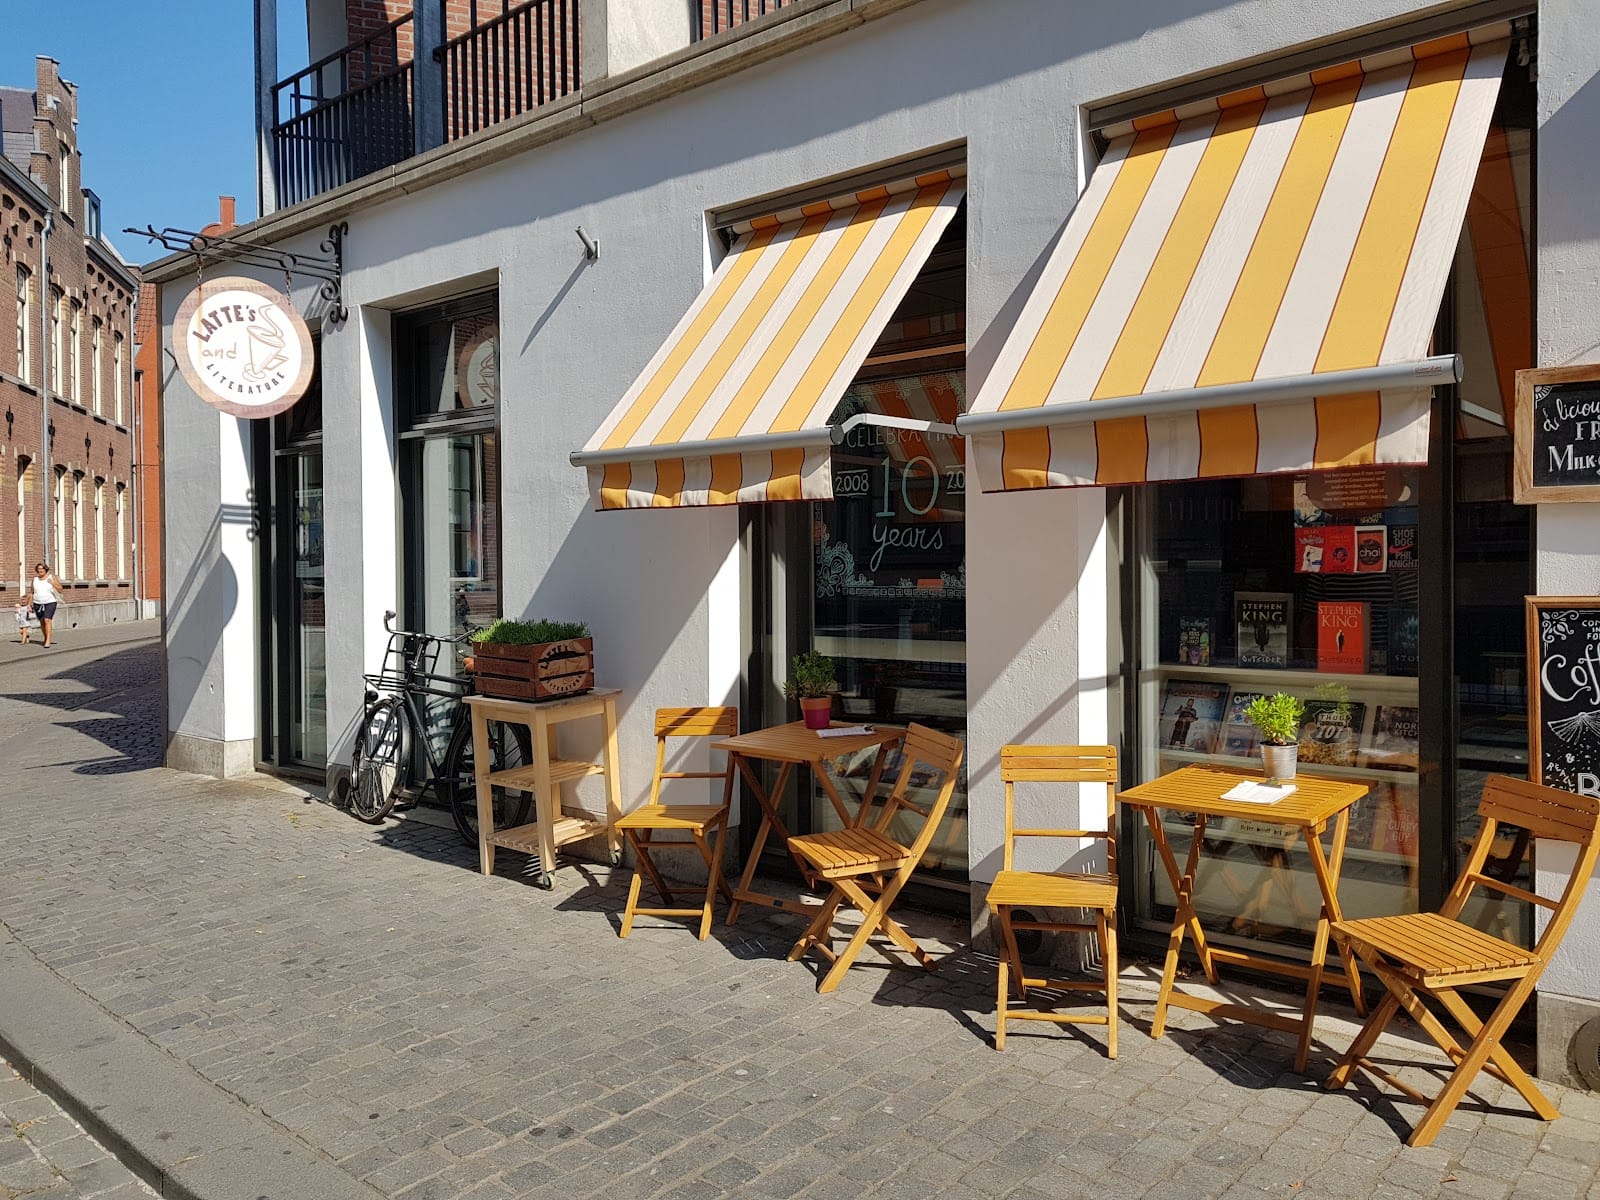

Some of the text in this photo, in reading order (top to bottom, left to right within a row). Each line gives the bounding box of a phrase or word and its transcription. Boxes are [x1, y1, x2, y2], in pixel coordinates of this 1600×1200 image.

[192, 304, 256, 343] LATTE'S
[201, 341, 237, 359] and
[206, 363, 285, 395] LITERATURE
[835, 474, 869, 493] 2008
[875, 455, 940, 518] 10
[1392, 528, 1415, 538] SHOE
[870, 522, 943, 573] years
[1394, 538, 1413, 547] DOG
[1395, 551, 1412, 560] PHIL
[1242, 602, 1282, 611] STEPHEN
[1318, 605, 1362, 615] STEPHEN
[1242, 611, 1282, 622] KING
[1321, 615, 1358, 628] KING
[1242, 655, 1282, 665] OUTSIDER
